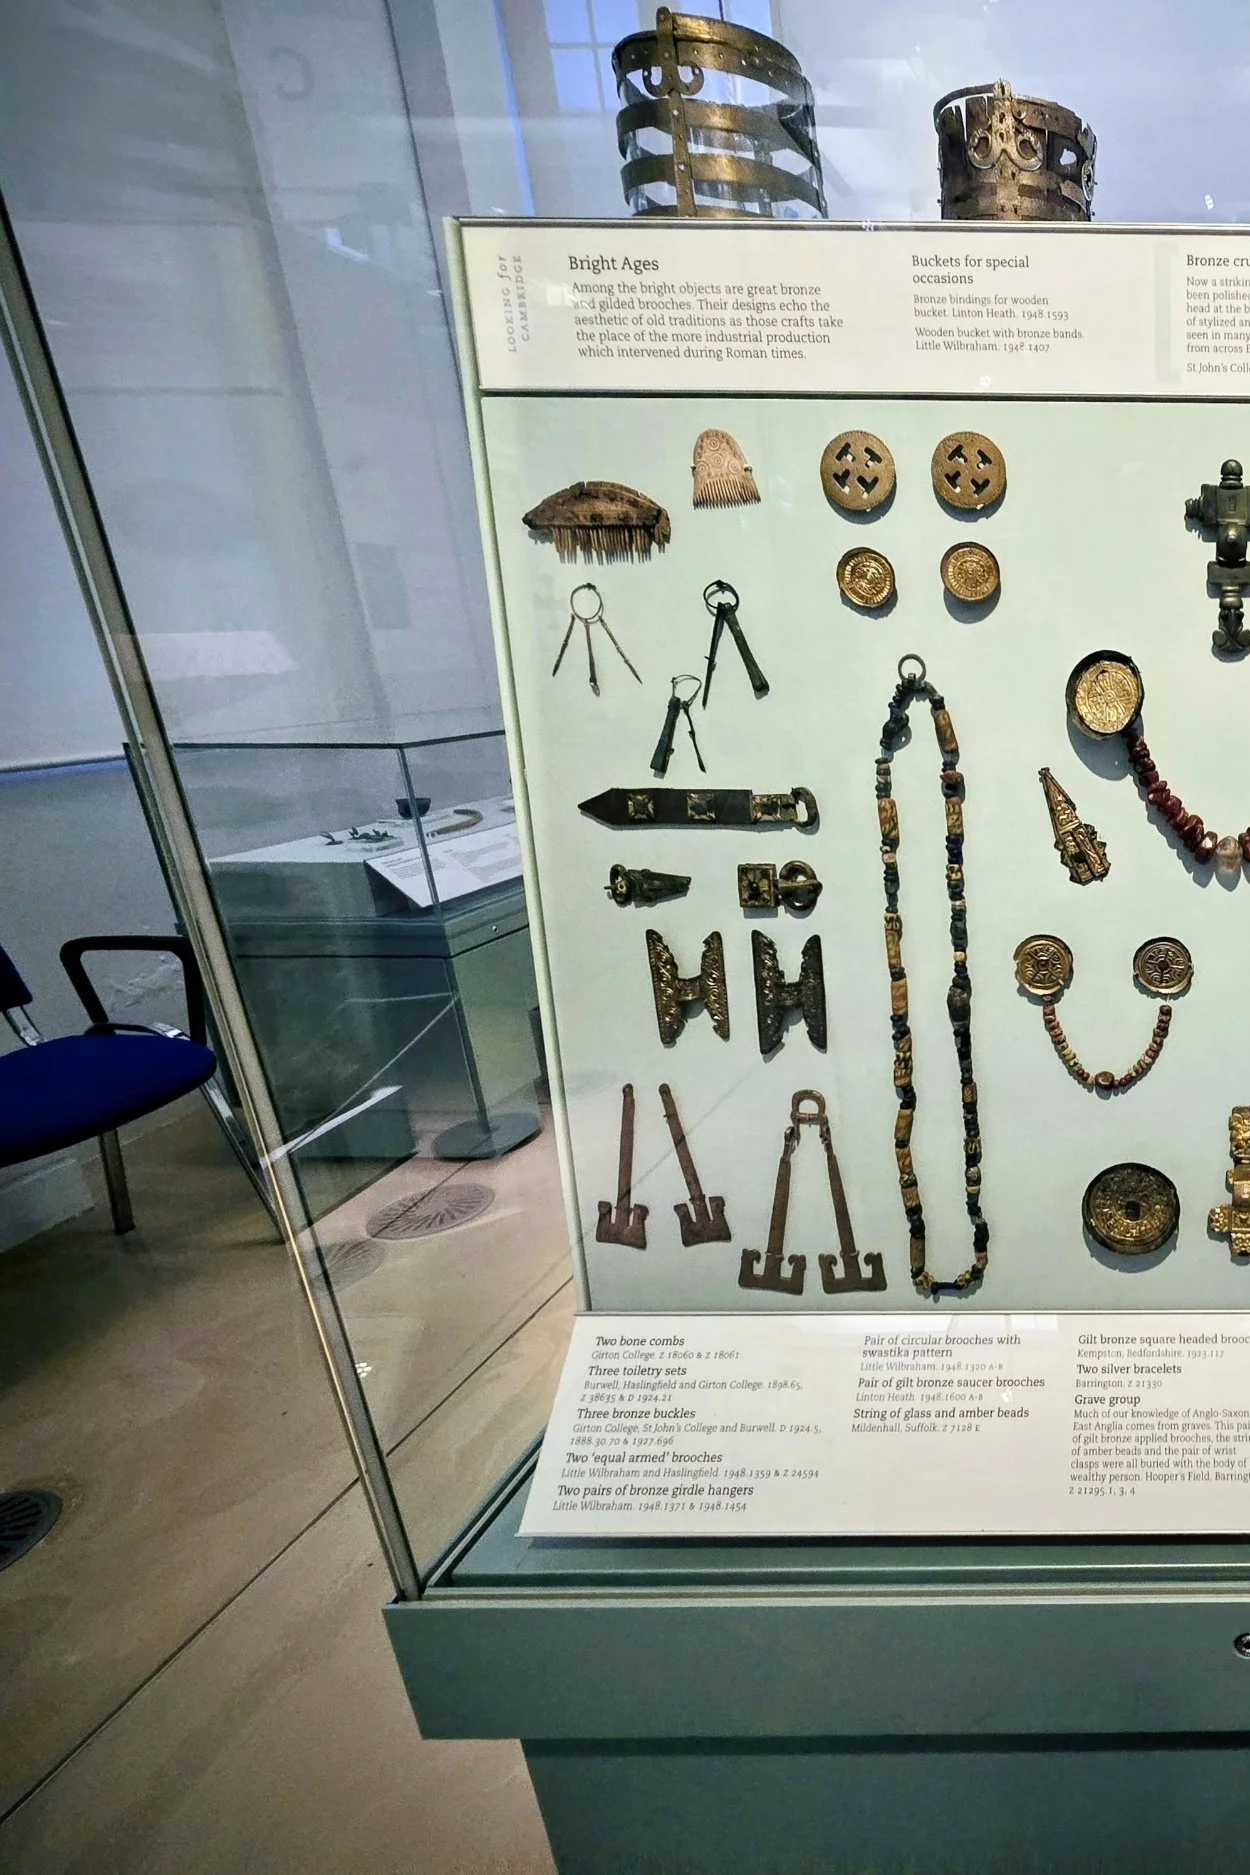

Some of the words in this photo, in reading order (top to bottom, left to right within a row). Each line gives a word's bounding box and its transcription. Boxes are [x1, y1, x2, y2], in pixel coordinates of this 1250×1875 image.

[568, 256, 618, 275] Bright
[620, 257, 659, 275] Ages
[911, 254, 961, 267] Buckets
[964, 255, 983, 267] for
[985, 255, 1029, 271] special
[1186, 254, 1230, 266] Bronze
[497, 255, 511, 281] for
[912, 271, 974, 284] occasions
[571, 281, 615, 298] Among
[616, 281, 637, 293] the
[638, 281, 676, 297] bright
[678, 282, 722, 297] objects
[724, 286, 744, 295] are
[746, 284, 778, 298] great
[779, 282, 821, 295] bronze
[513, 255, 530, 342] CAMBRIDGE
[501, 287, 517, 353] LOOKING
[574, 313, 629, 325] aesthetic
[631, 313, 644, 326] of
[646, 313, 666, 326] old
[668, 314, 726, 327] traditions
[729, 317, 743, 326] as
[745, 314, 778, 327] those
[780, 314, 815, 327] crafts
[817, 314, 844, 328] take
[575, 329, 596, 342] the
[598, 329, 631, 346] place
[632, 330, 646, 342] of
[648, 330, 669, 342] the
[670, 333, 703, 342] more
[704, 330, 763, 343] industrial
[765, 331, 831, 346] production
[577, 344, 614, 357] which
[616, 345, 681, 358] intervened
[682, 345, 723, 361] during
[725, 346, 768, 358] Roman
[1186, 362, 1197, 372] St
[595, 1335, 618, 1346] Two
[618, 1335, 647, 1346] bone
[648, 1335, 685, 1346] combs
[863, 1334, 886, 1345] Pair
[887, 1334, 900, 1345] of
[900, 1334, 944, 1345] circular
[944, 1333, 994, 1345] brooches
[996, 1333, 1021, 1344] with
[1077, 1333, 1097, 1344] Gilt
[1099, 1333, 1137, 1344] bronze
[1139, 1336, 1176, 1347] square
[1178, 1332, 1218, 1344] headed
[862, 1346, 910, 1358] swastika
[911, 1347, 953, 1360] pattern
[588, 1364, 620, 1376] Three
[622, 1364, 663, 1378] toiletry
[664, 1366, 687, 1376] sets
[1076, 1363, 1099, 1374] Two
[1100, 1362, 1131, 1374] silver
[1132, 1362, 1182, 1374] bracelets
[857, 1376, 880, 1388] Pair
[881, 1376, 895, 1388] of
[894, 1376, 914, 1390] gilt
[915, 1376, 954, 1387] bronze
[956, 1378, 994, 1387] saucer
[995, 1375, 1045, 1387] brooches
[1074, 1394, 1106, 1404] Grave
[1108, 1395, 1141, 1407] group
[576, 1406, 610, 1419] Three
[611, 1407, 651, 1419] bronze
[652, 1406, 696, 1419] buckles
[852, 1407, 888, 1421] String
[889, 1406, 903, 1418] of
[902, 1406, 932, 1421] glass
[934, 1406, 956, 1418] and
[958, 1406, 995, 1418] amber
[996, 1406, 1029, 1418] beads
[565, 1451, 589, 1463] Two
[671, 1450, 723, 1463] brooches
[557, 1484, 581, 1496] Two
[581, 1483, 613, 1499] pairs
[614, 1483, 629, 1496] of
[628, 1483, 669, 1495] bronze
[670, 1483, 705, 1499] girdle
[707, 1483, 754, 1498] hangers
